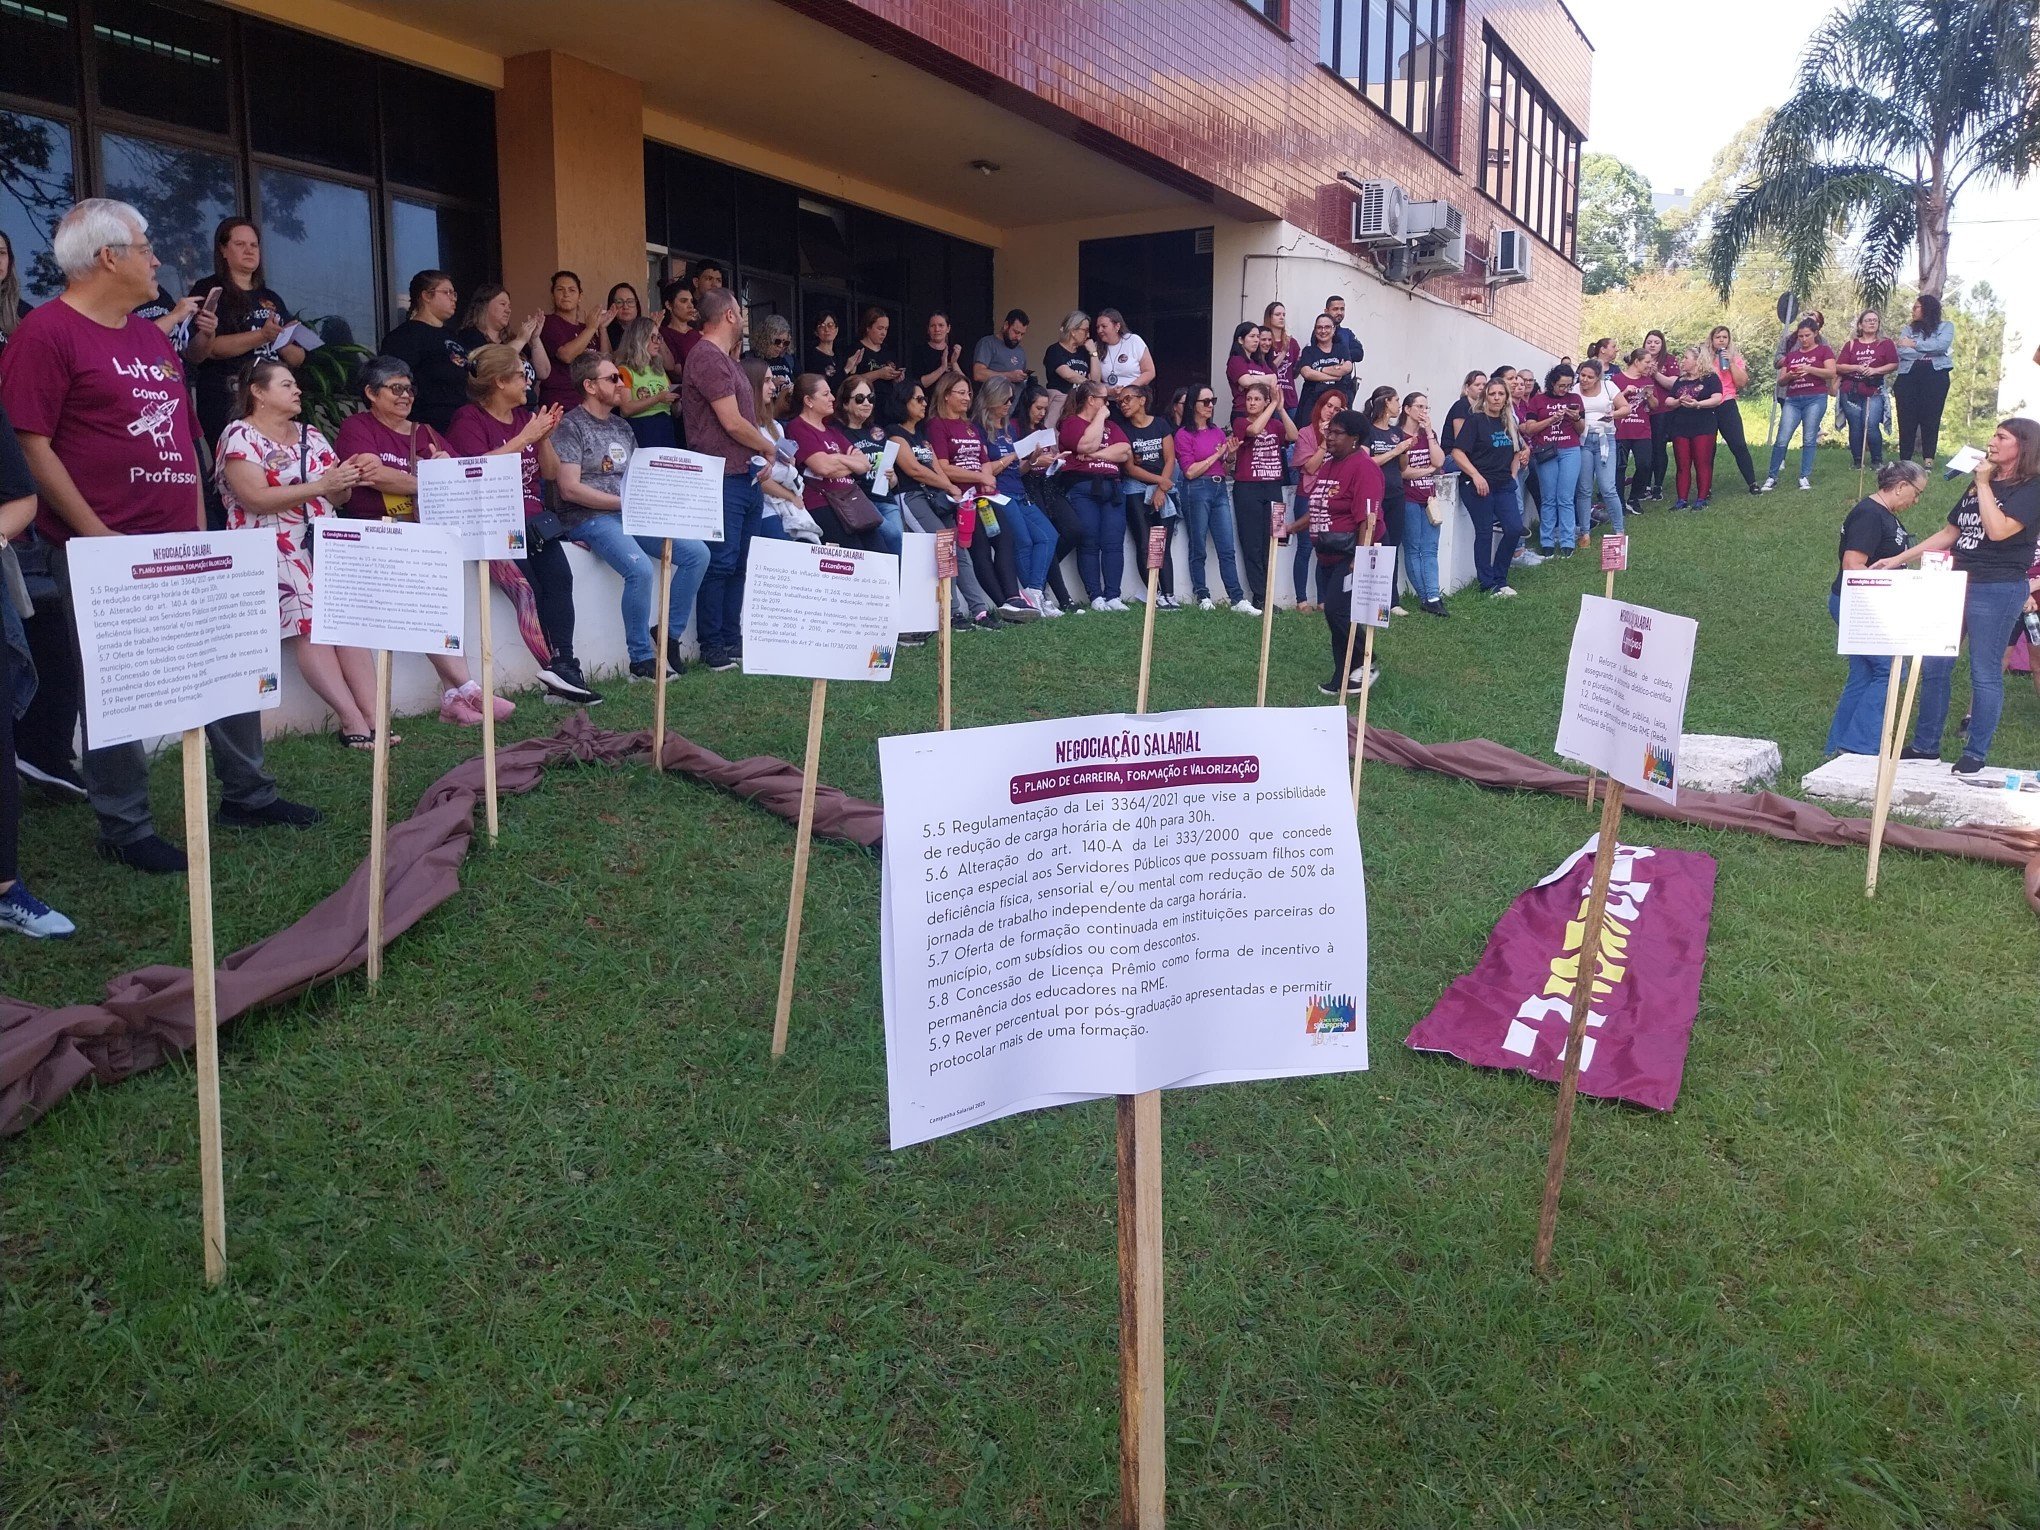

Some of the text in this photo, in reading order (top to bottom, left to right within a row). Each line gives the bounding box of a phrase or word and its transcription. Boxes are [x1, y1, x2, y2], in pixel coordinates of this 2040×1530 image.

[112, 357, 164, 381] Lute
[133, 388, 168, 400] como
[130, 467, 196, 483] Professo
[160, 451, 182, 461] um
[104, 582, 158, 594] Regulamentação
[1056, 730, 1201, 763] NEGOCIAÇÃO SALARIAL
[1639, 727, 1650, 737] RME
[1651, 730, 1667, 742] (Rede
[1654, 718, 1667, 731] laica,
[1012, 760, 1257, 794] 5. PLANO DE CARREIRA, FORMAÇÃO E VALORIZAÇÃO
[924, 785, 1326, 838] 5.5 Regulamentação da Lei 3364/2021 que vise a possibilidade
[924, 810, 1214, 860] de redução de carga horária de 40h para 30h.
[926, 824, 1331, 882] 5.6 Alteração do art. 140-A da Lei 333/2000 que concede
[926, 847, 1333, 904] licença especial aos Servidores Públicos que possuam filhos com
[927, 864, 1334, 925] deficiência física, sensorial e/ou mental com redução de 50% da
[927, 889, 1246, 951] jornada de trabalho independente da carga horária.
[928, 903, 1335, 967] 5.7 Oferta de formação continuada em instituições parceiras do
[928, 933, 1199, 989] município, com subsídios ou com descontos.
[928, 942, 1334, 1009] 5.8 Concessão de Licença Prêmio como forma de incentivo à
[929, 976, 1167, 1034] permanência dos educadores na RME.
[929, 981, 1332, 1052] 5.9 Rever percentual por pós-graduação apresentadas e permitir
[930, 1022, 1148, 1076] protocolar mais de uma formação.
